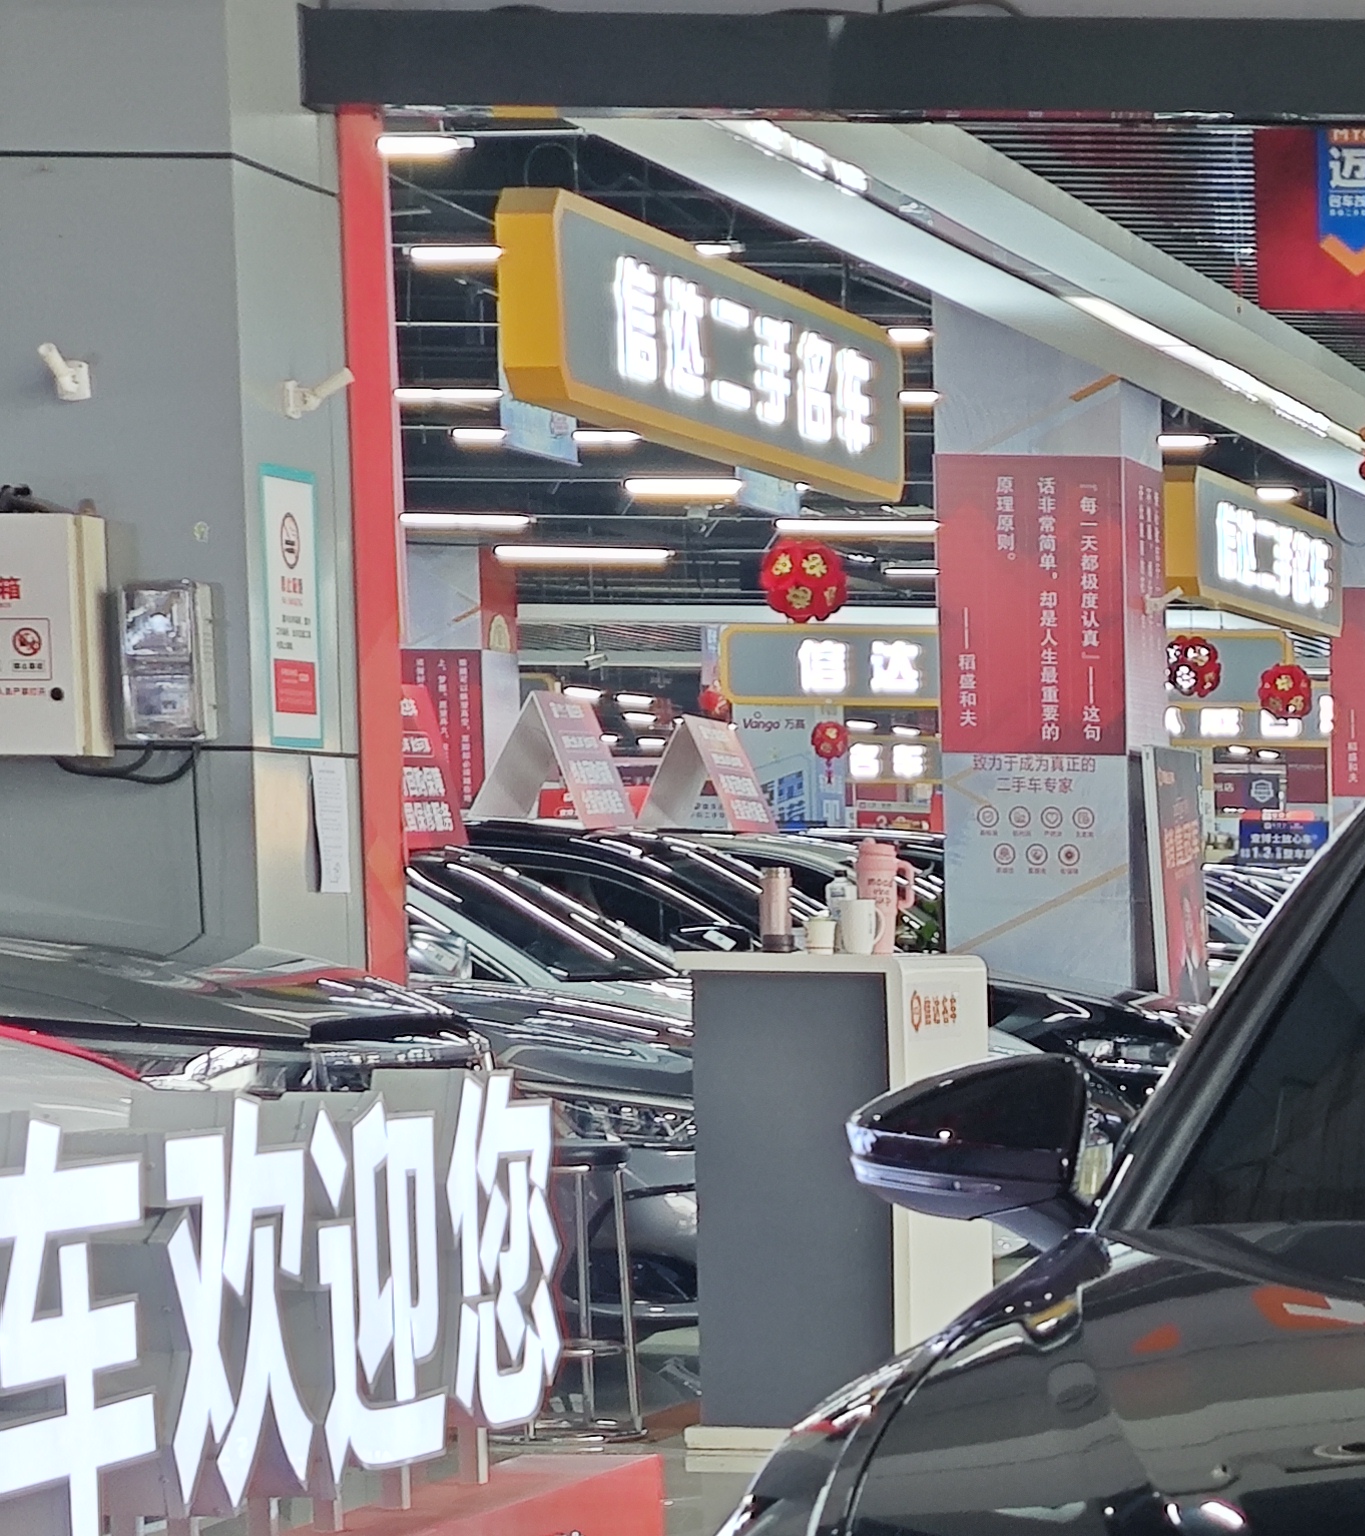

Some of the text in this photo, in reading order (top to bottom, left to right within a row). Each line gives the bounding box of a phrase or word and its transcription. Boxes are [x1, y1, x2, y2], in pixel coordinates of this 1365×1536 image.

[612, 255, 874, 454] 信达二手名车
[797, 638, 920, 694] 信达
[743, 717, 780, 731] Vango
[973, 755, 1096, 773] 致力于成为真正的
[997, 777, 1073, 794] 二手车专家
